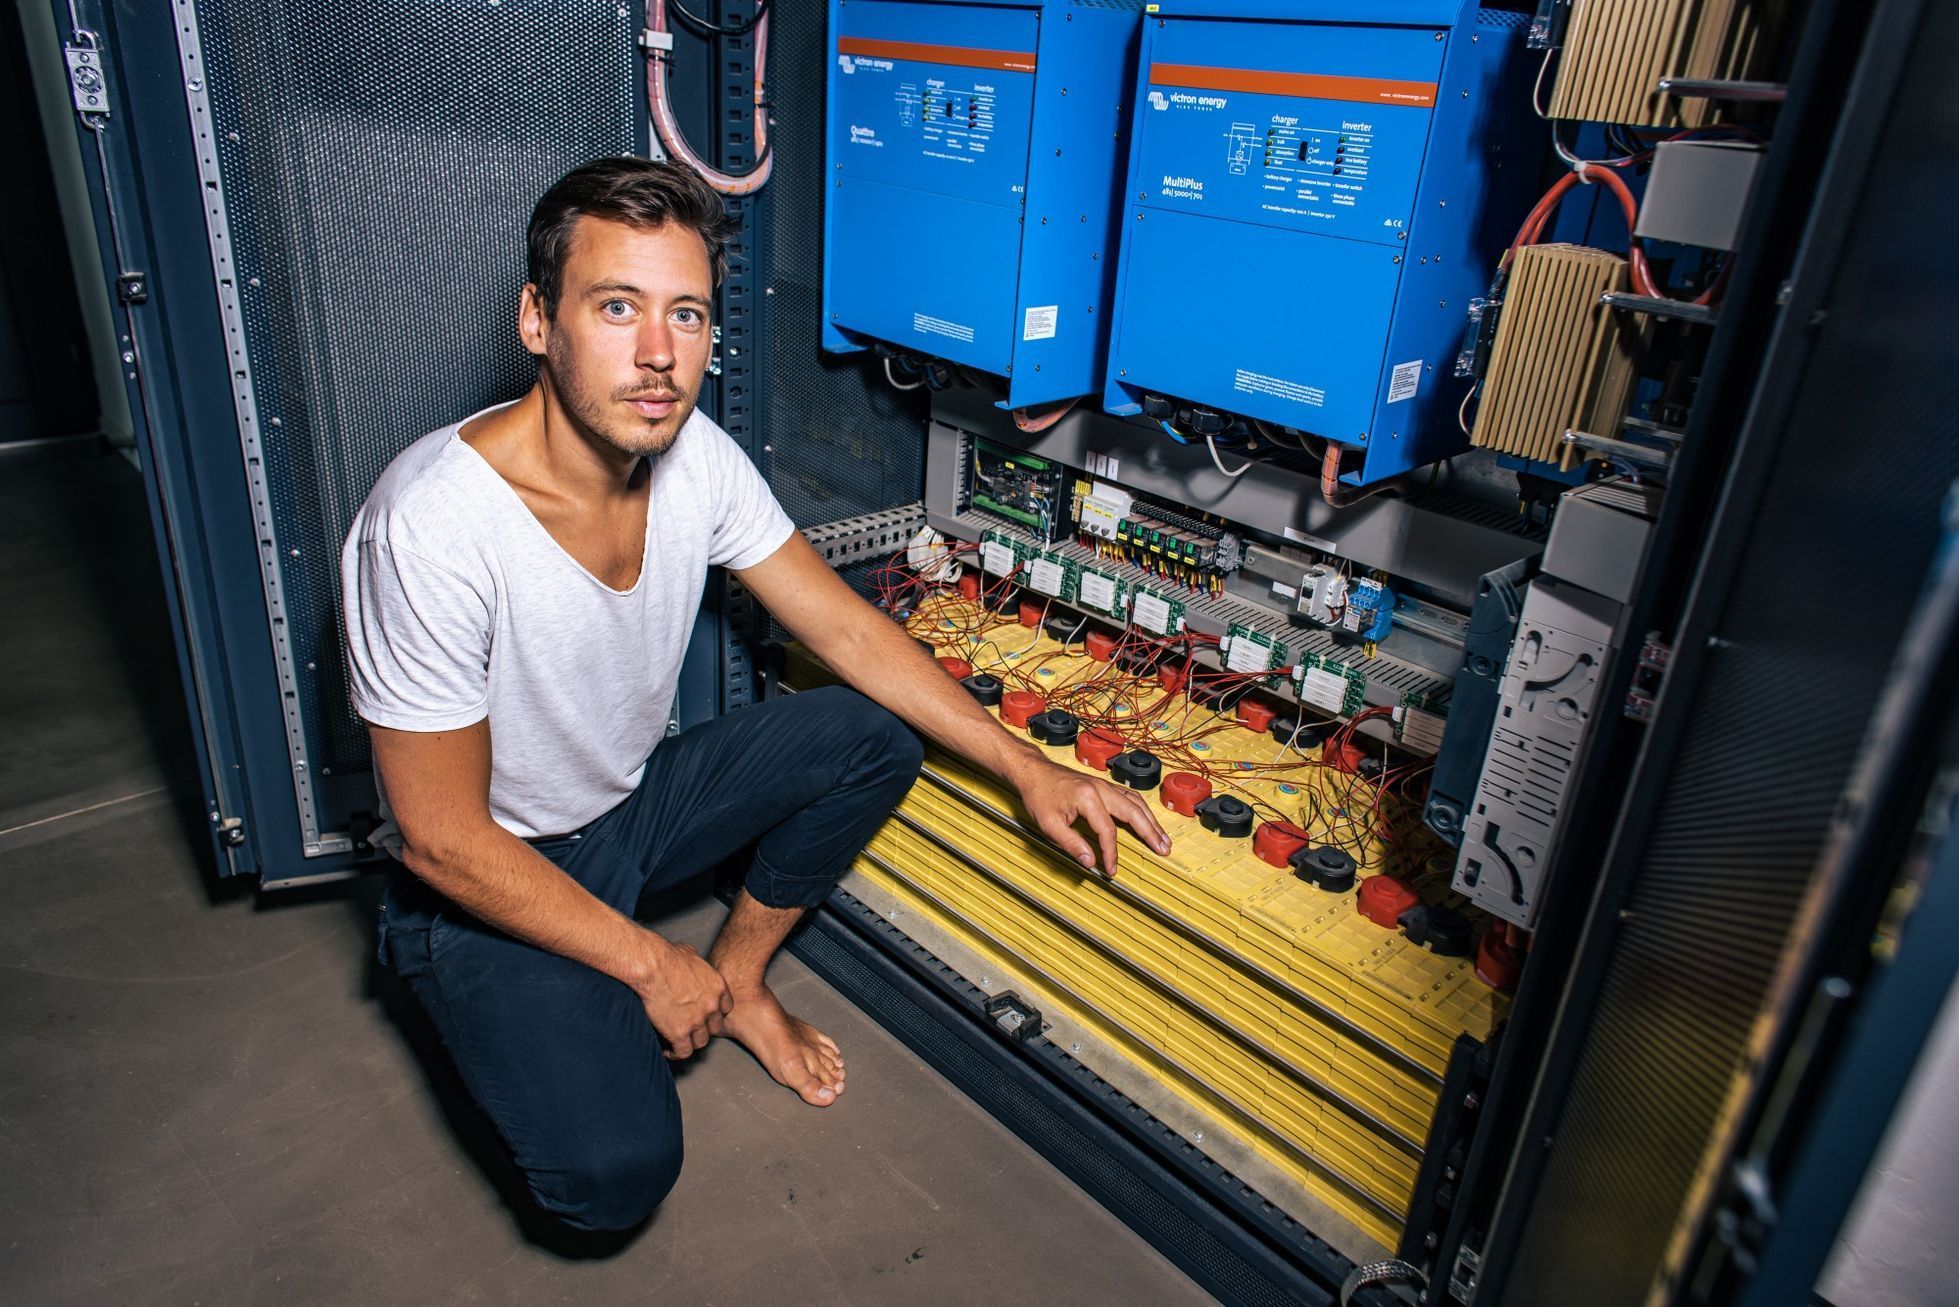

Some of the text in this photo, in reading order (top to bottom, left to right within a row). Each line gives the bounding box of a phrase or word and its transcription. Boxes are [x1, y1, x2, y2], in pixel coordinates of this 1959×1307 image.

[1170, 92, 1227, 109] victron energy
[1272, 115, 1299, 126] charger
[1342, 121, 1372, 132] inverter
[1163, 176, 1203, 190] MultiPlus
